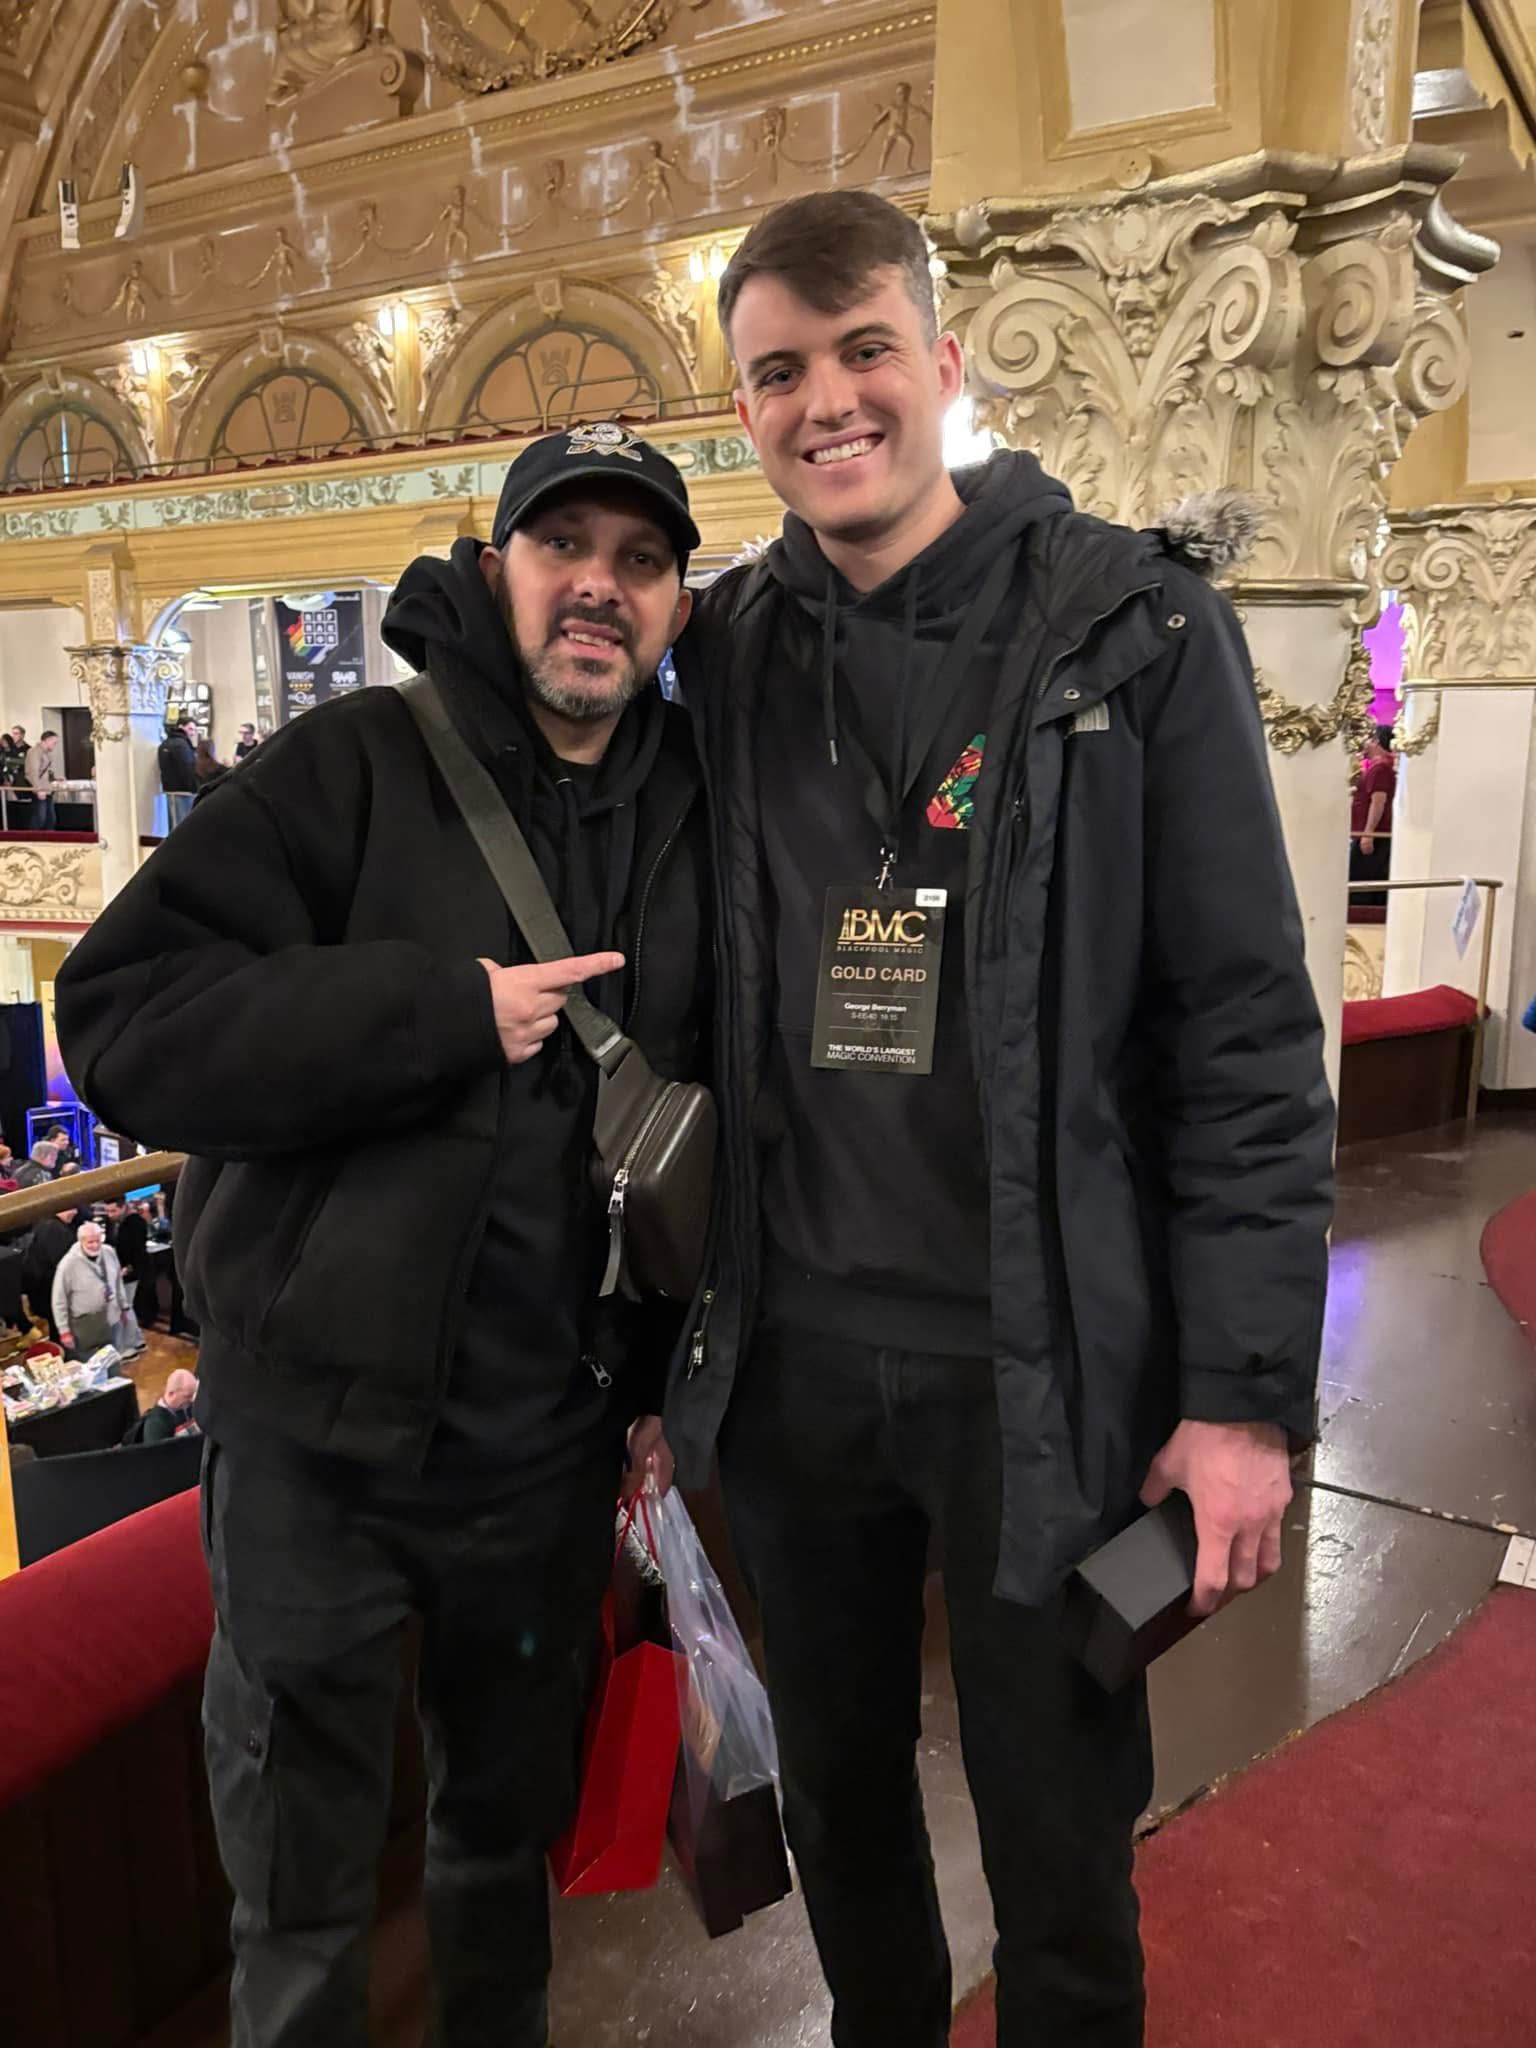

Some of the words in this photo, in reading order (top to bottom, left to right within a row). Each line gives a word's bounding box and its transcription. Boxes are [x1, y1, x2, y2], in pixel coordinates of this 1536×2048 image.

[849, 908, 927, 943] BMC
[836, 945, 889, 953] BLACKPOOL
[831, 965, 876, 980] GOLD
[880, 967, 927, 982] CARD
[844, 1002, 870, 1011] George
[844, 1045, 879, 1053] WORLD'S
[880, 1047, 916, 1056] LARGEST
[826, 1051, 857, 1061] MAGIC
[857, 1053, 916, 1064] CONVENTION
